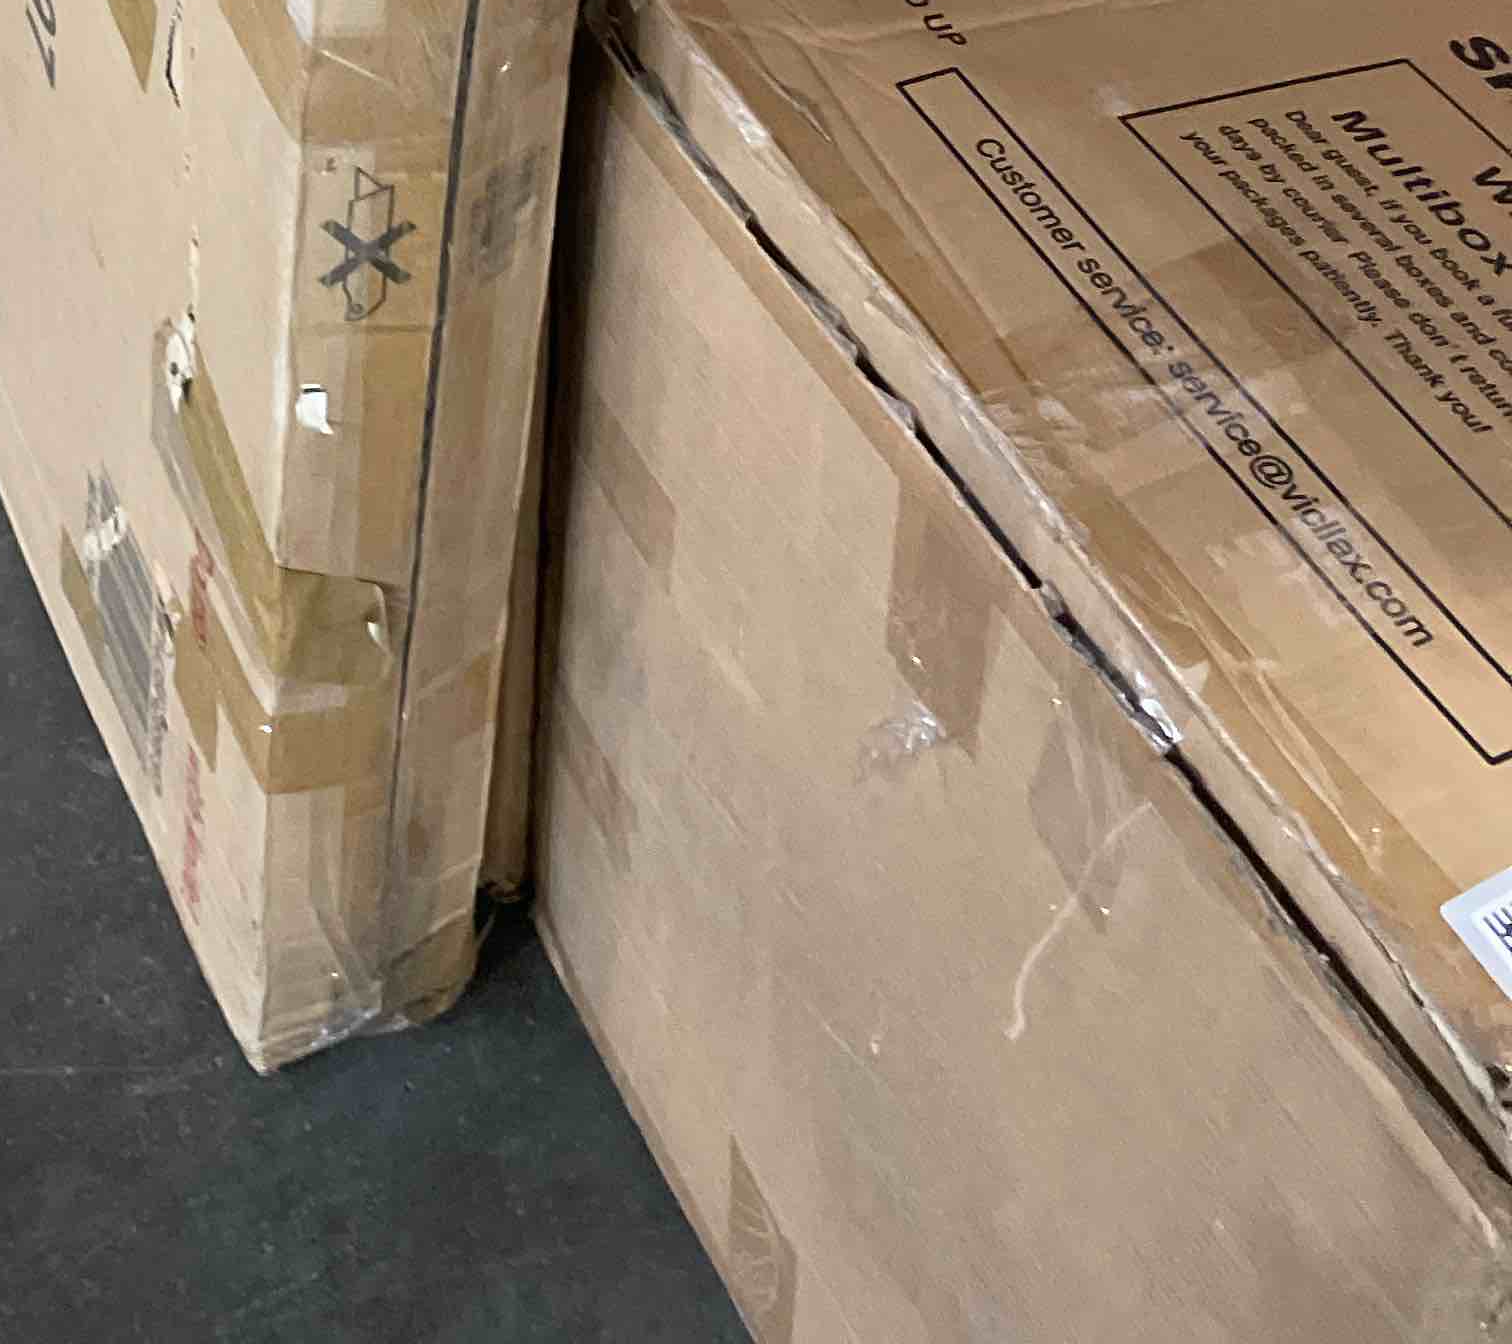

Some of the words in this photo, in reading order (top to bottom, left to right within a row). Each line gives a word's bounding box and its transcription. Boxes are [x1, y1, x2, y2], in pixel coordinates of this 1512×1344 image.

[923, 13, 967, 46] UP
[974, 136, 1087, 253] Customer
[1077, 256, 1176, 355] service:
[1180, 130, 1228, 167] your
[1218, 170, 1307, 247] packages
[1384, 328, 1445, 389] Thank
[1434, 390, 1494, 433] you!
[1218, 125, 1262, 161] days
[1259, 163, 1287, 185] by
[1347, 250, 1411, 309] Please
[1248, 118, 1318, 173] packed
[1312, 174, 1335, 191] in
[1331, 193, 1405, 252] several
[1396, 254, 1454, 308] boxes
[1450, 311, 1497, 346] and
[1285, 110, 1329, 145] Dear
[1389, 214, 1433, 245] you
[1429, 247, 1481, 291] book
[1477, 294, 1495, 306] a
[1330, 110, 1512, 277] Multibox
